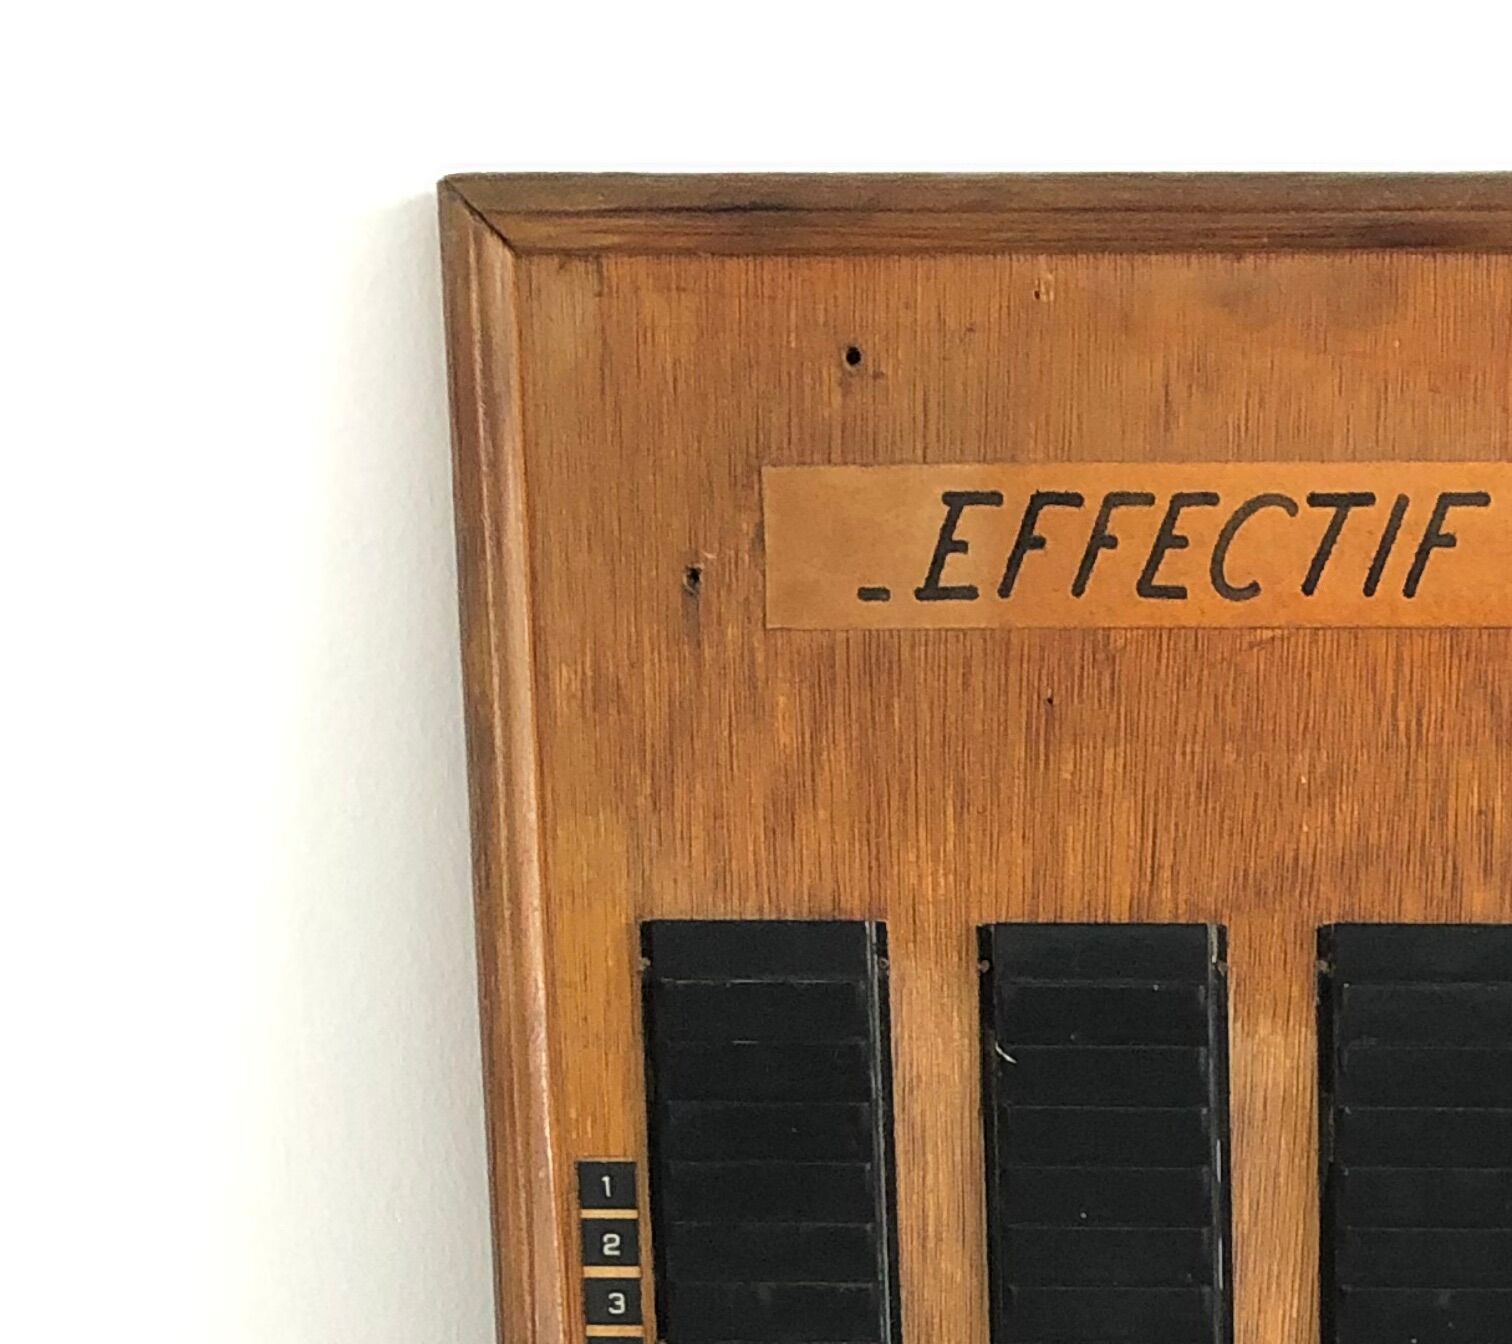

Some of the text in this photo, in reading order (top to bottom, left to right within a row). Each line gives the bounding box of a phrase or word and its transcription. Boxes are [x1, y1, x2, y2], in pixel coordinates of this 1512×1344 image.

[600, 1174, 612, 1198] 1
[601, 1232, 622, 1257] 2
[607, 1291, 627, 1315] 3
